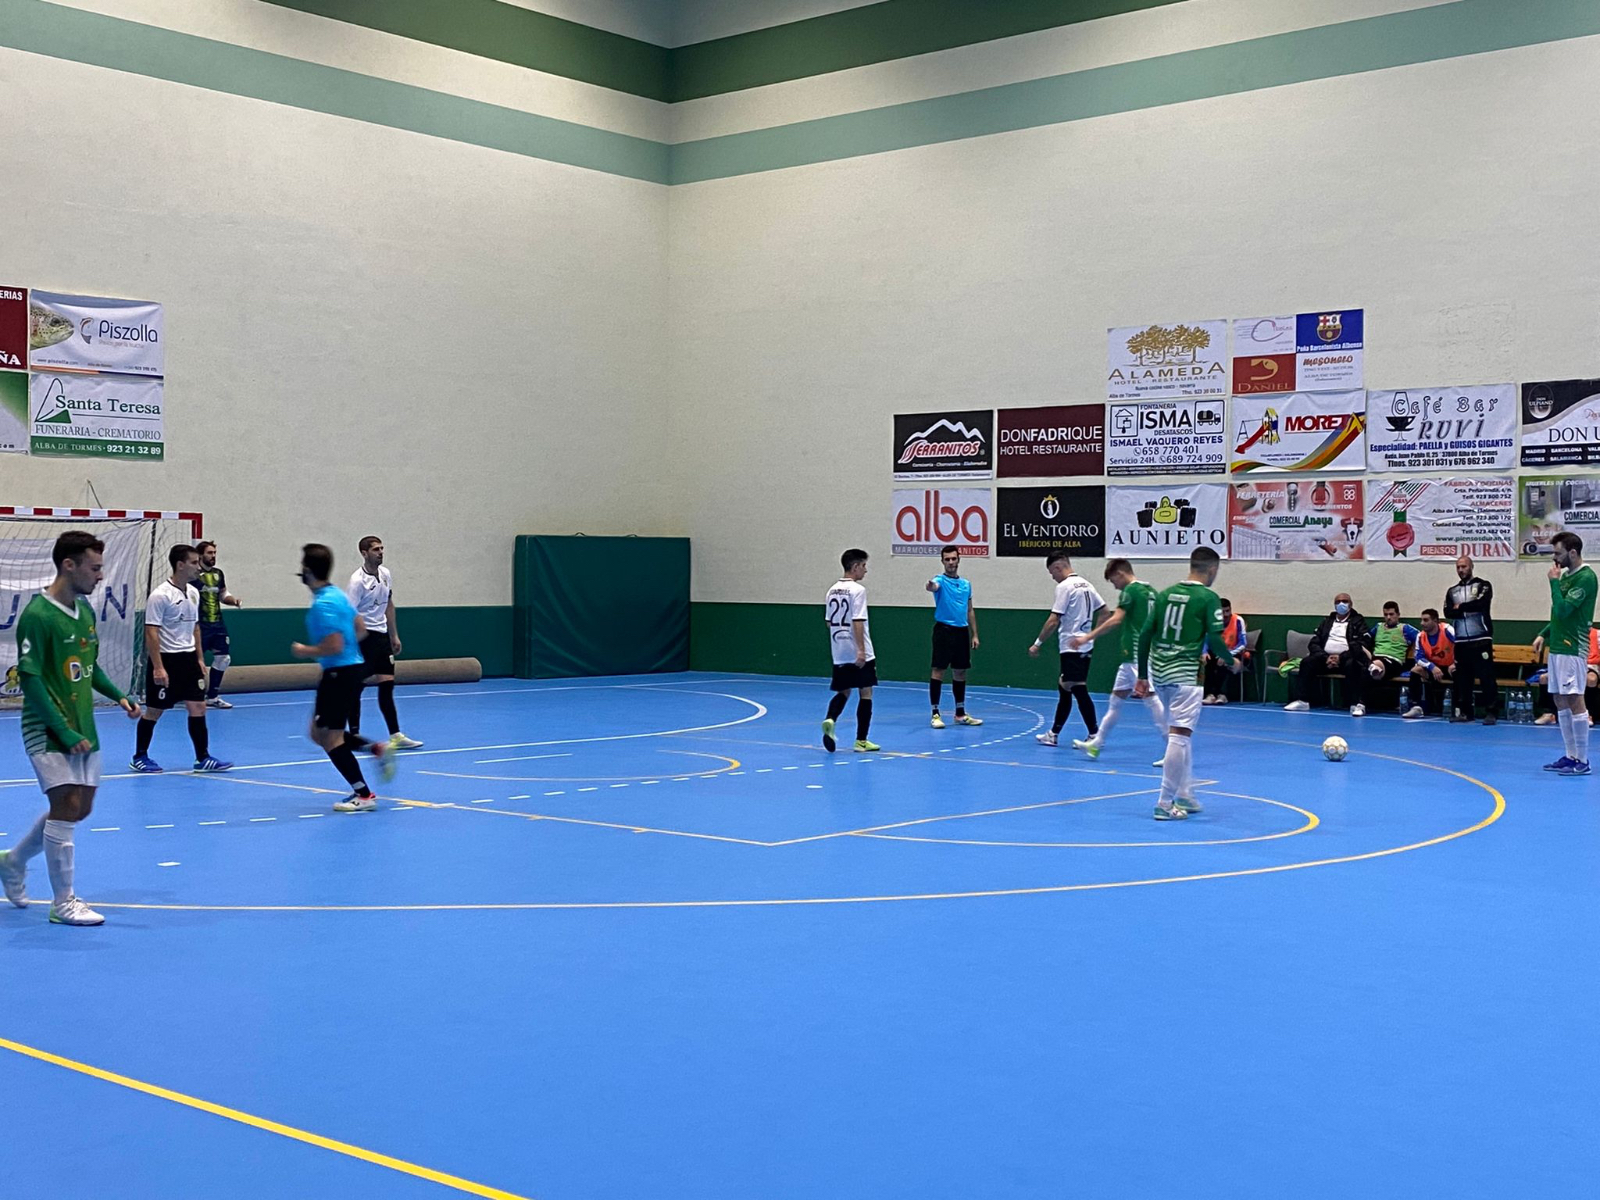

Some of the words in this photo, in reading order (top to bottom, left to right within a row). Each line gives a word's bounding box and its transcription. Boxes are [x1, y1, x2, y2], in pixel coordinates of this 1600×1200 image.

[99, 320, 158, 343] Piszolla
[1108, 362, 1226, 381] ALAMEDA
[1152, 374, 1218, 383] RESTAURANTE
[56, 395, 102, 411] Santa
[107, 399, 161, 415] Teresa
[1394, 396, 1443, 421] Café
[1456, 396, 1499, 413] Bar
[1139, 409, 1193, 430] ISMA
[35, 424, 91, 438] FUNERARIA
[98, 428, 161, 440] CREMATORIO
[1000, 425, 1103, 443] DONFADRIQUE
[1154, 428, 1194, 436] DESATASCOS
[1549, 427, 1588, 443] DON
[34, 442, 56, 450] ALBA
[72, 444, 102, 452] TORMES
[107, 445, 123, 453] 923
[125, 445, 135, 454] 21
[138, 446, 149, 455] 32
[151, 447, 161, 455] 89
[1000, 445, 1031, 455] HOTEL
[1032, 443, 1103, 455] RESTAURANTE
[1110, 438, 1143, 447] ISMAEL
[1145, 437, 1190, 446] VAQUERO
[1193, 436, 1223, 445] REYES
[1370, 443, 1418, 452] Especialidad:
[1419, 441, 1443, 450] PAELLA
[1449, 440, 1477, 449] GUISOS
[1478, 439, 1514, 448] GIGANTES
[1142, 447, 1159, 456] 658
[1162, 446, 1180, 455] 770
[1182, 445, 1199, 454] 401
[1109, 457, 1138, 465] Servicio
[1166, 455, 1184, 464] 689
[1186, 454, 1203, 463] 724
[1205, 453, 1223, 462] 909
[1408, 459, 1421, 467] 923
[1453, 458, 1466, 466] 676
[1467, 457, 1480, 465] 962
[1481, 457, 1495, 465] 340
[895, 490, 989, 543] alba
[1269, 515, 1302, 525] COMERCIAL
[1302, 515, 1333, 529] Anaya
[1564, 511, 1600, 521] COMERCIA
[1004, 523, 1018, 537] EL
[1022, 523, 1099, 539] VENTORRO
[1112, 529, 1226, 545] AUNIETO
[895, 546, 938, 555] MARMOLES
[1052, 540, 1063, 548] DE
[1063, 540, 1082, 548] ALBA
[1421, 546, 1457, 555] PIENSOS
[1461, 542, 1512, 558] DURAN
[829, 598, 850, 627] 22
[1161, 602, 1187, 641] 14
[158, 688, 165, 700] 6
